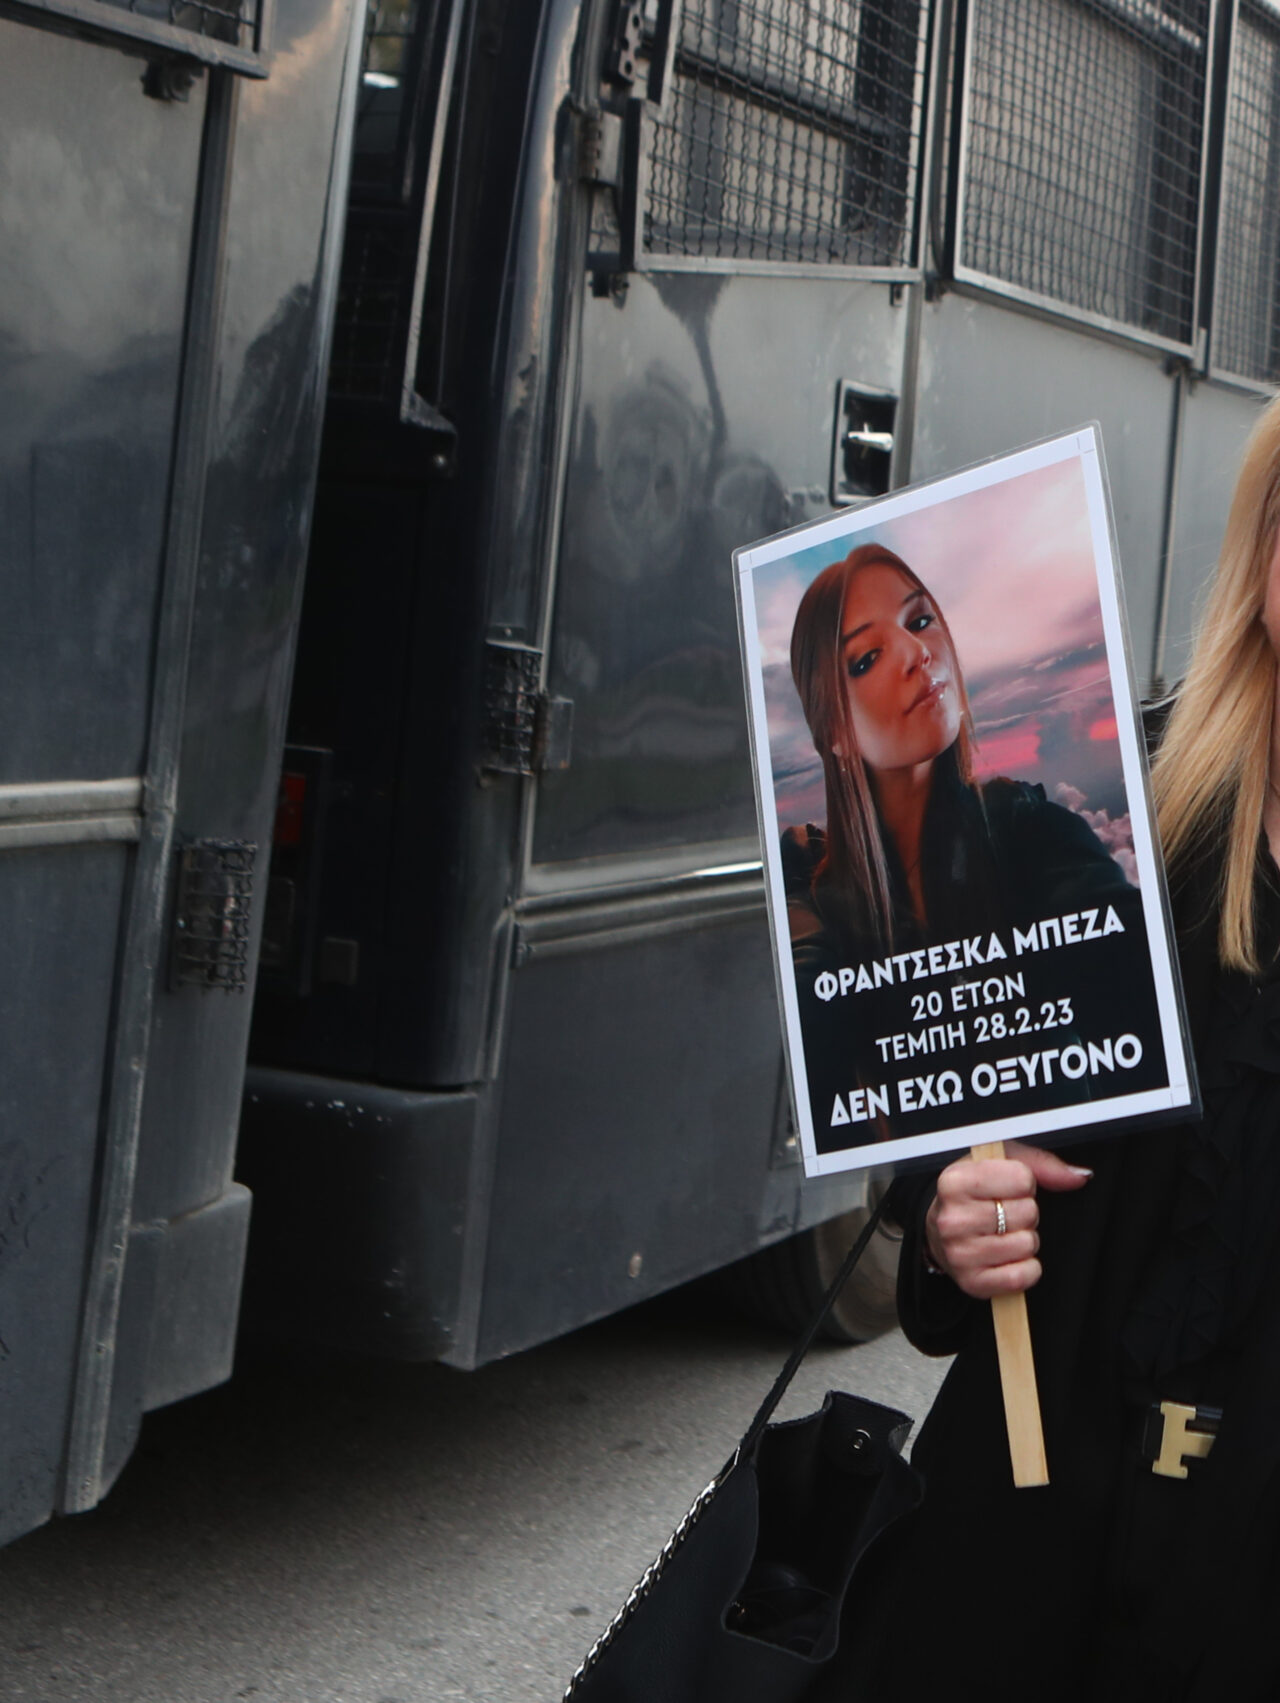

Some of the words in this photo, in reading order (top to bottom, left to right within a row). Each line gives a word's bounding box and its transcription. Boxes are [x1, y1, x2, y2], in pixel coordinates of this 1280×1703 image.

[814, 932, 1007, 1002] ΦΡΑΝΤΣΕΣΚΑ
[1012, 904, 1125, 956] ΜΠΕΖΑ
[875, 1020, 966, 1063] ΤΕΜΠΗ
[973, 997, 1074, 1043] 28.2.23
[910, 991, 943, 1021] 20
[950, 971, 1026, 1012] ΕΤΩΝ
[830, 1084, 889, 1127] ΔΕΝ
[897, 1070, 964, 1113] ΕΧΩ
[970, 1033, 1143, 1097] ΟΞΥΓΟΝΟ
